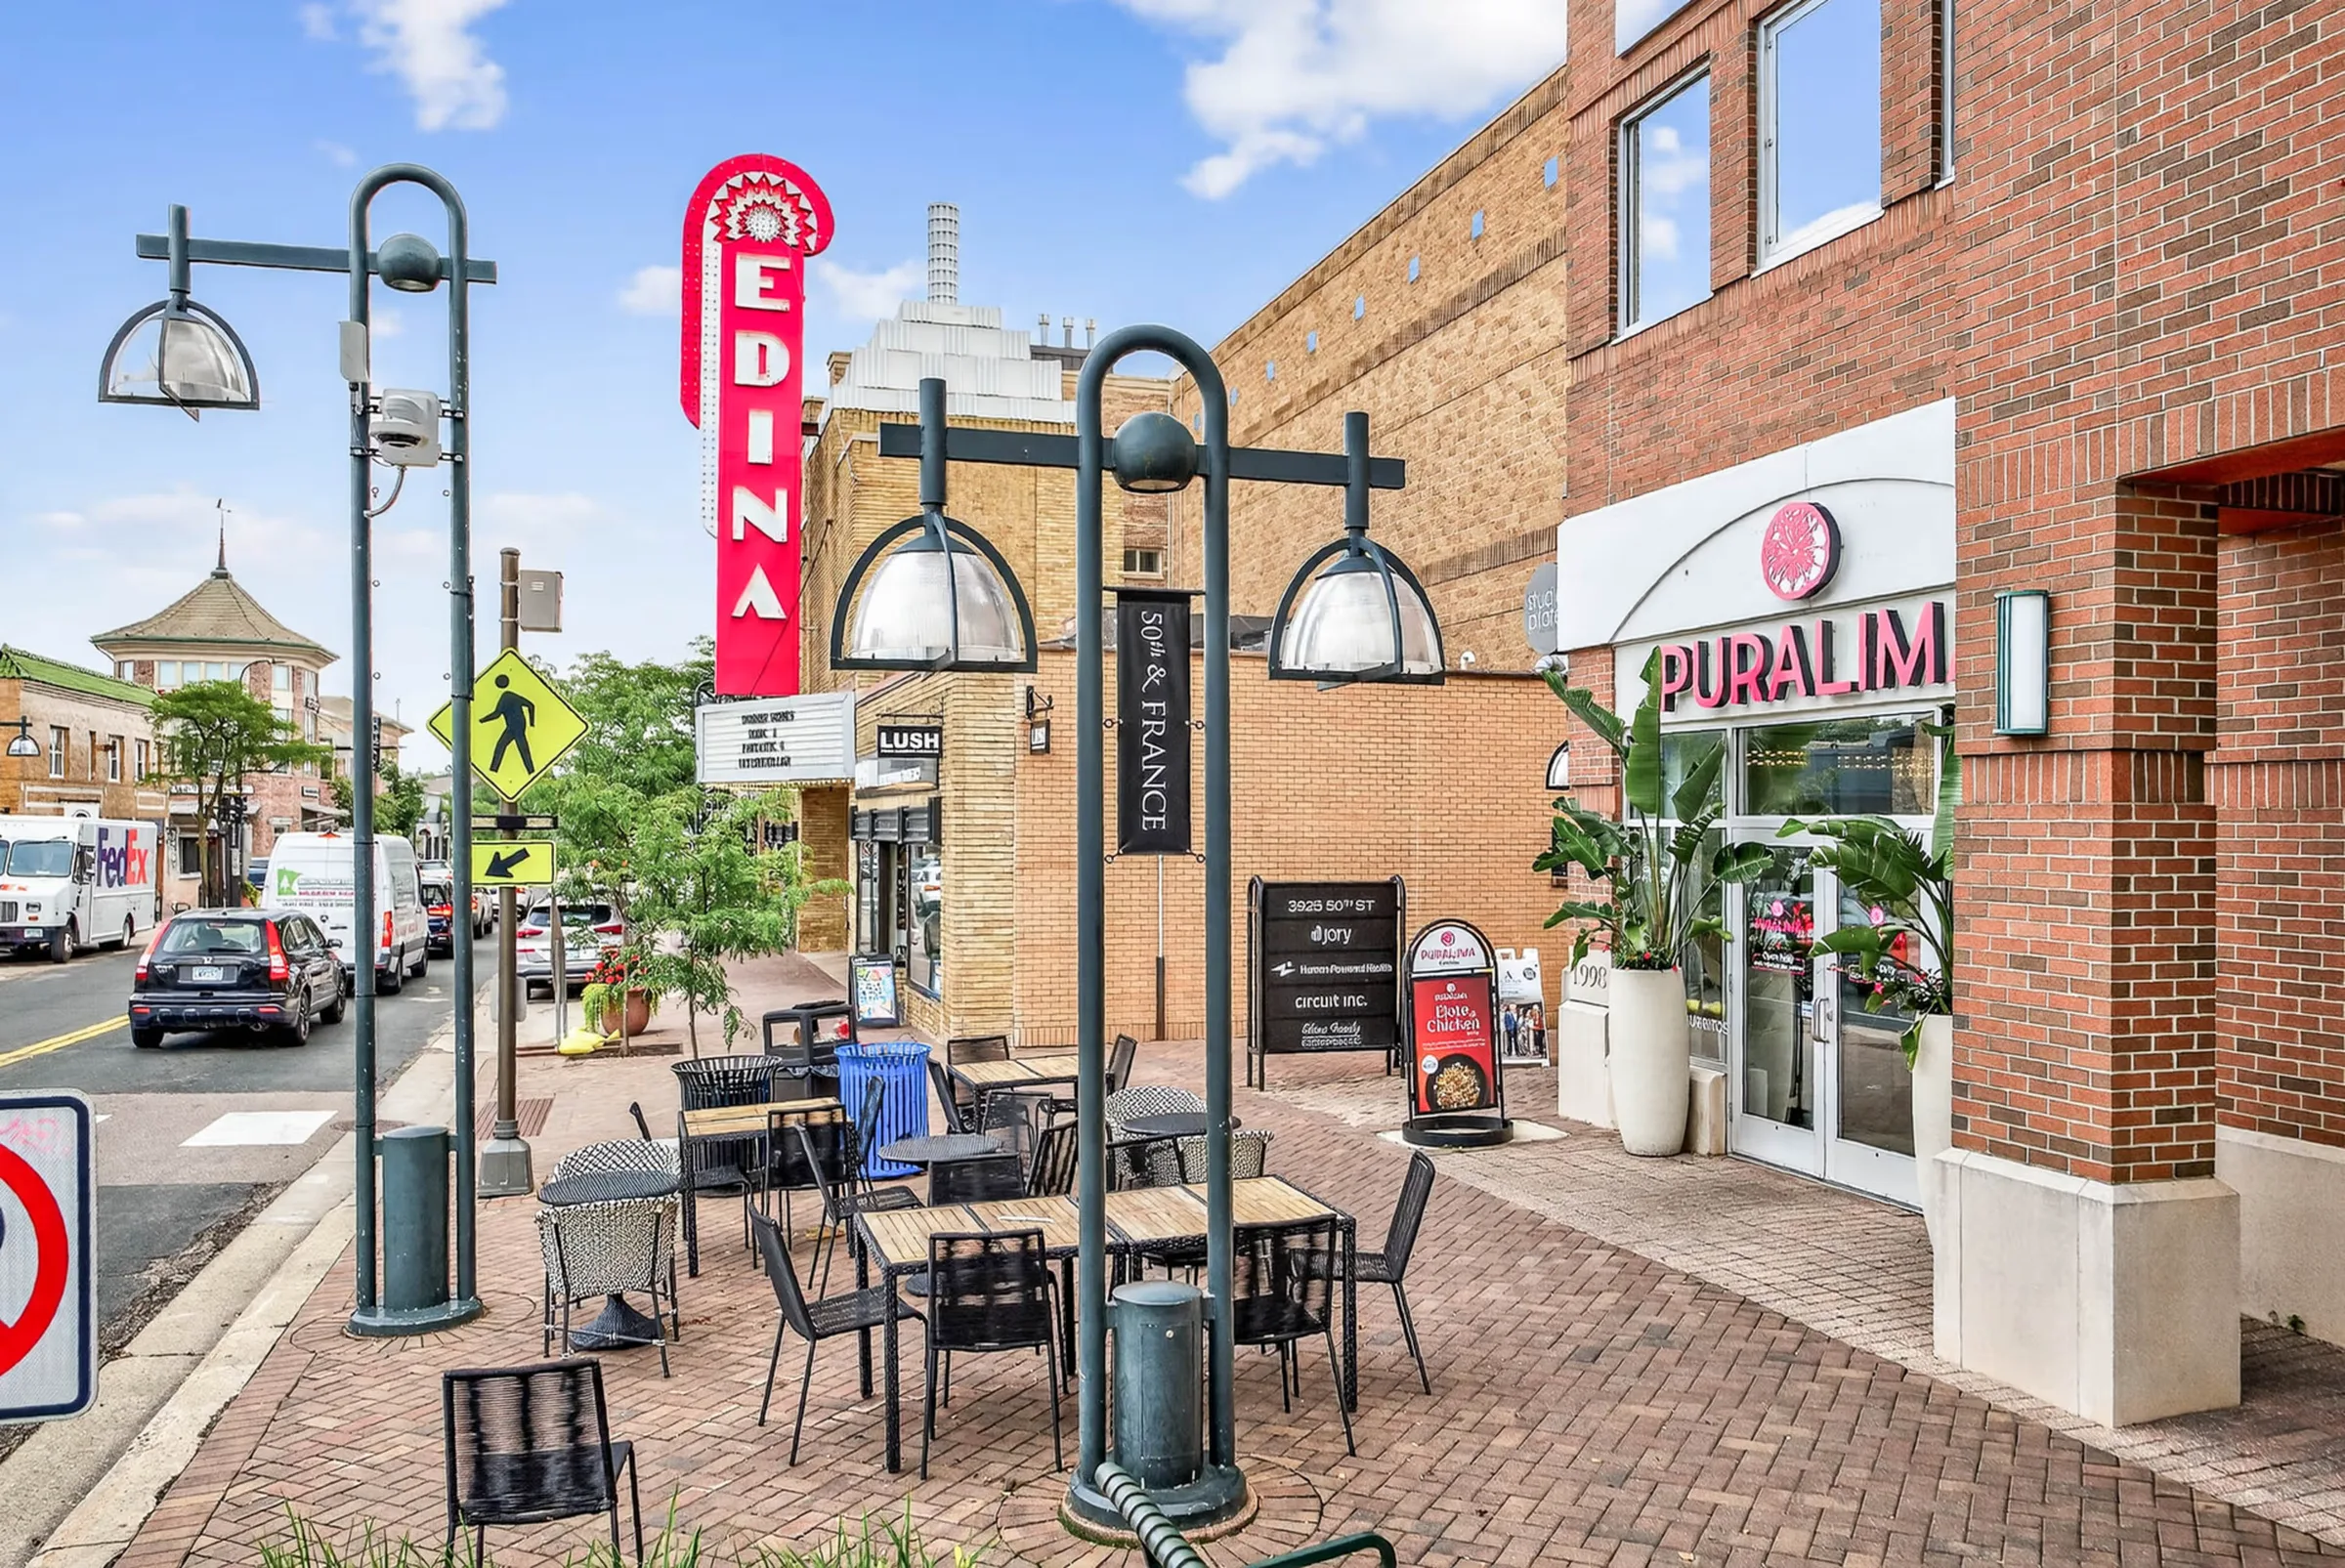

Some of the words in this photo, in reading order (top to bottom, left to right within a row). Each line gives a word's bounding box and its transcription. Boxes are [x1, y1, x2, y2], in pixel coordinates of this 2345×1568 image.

[731, 254, 791, 619] EDINA
[1140, 611, 1167, 657] 50th
[1141, 663, 1167, 693] &
[880, 732, 939, 749] LUSH
[1141, 700, 1167, 830] FRANCE
[97, 827, 149, 888] FedEx
[1288, 900, 1323, 912] 3925
[1355, 899, 1376, 911] ST
[1573, 963, 1607, 990] 1998
[1295, 994, 1340, 1009] circuit
[1343, 995, 1368, 1007] inc.
[1427, 1017, 1480, 1034] Chicken
[1686, 1015, 1729, 1036] URRITOS
